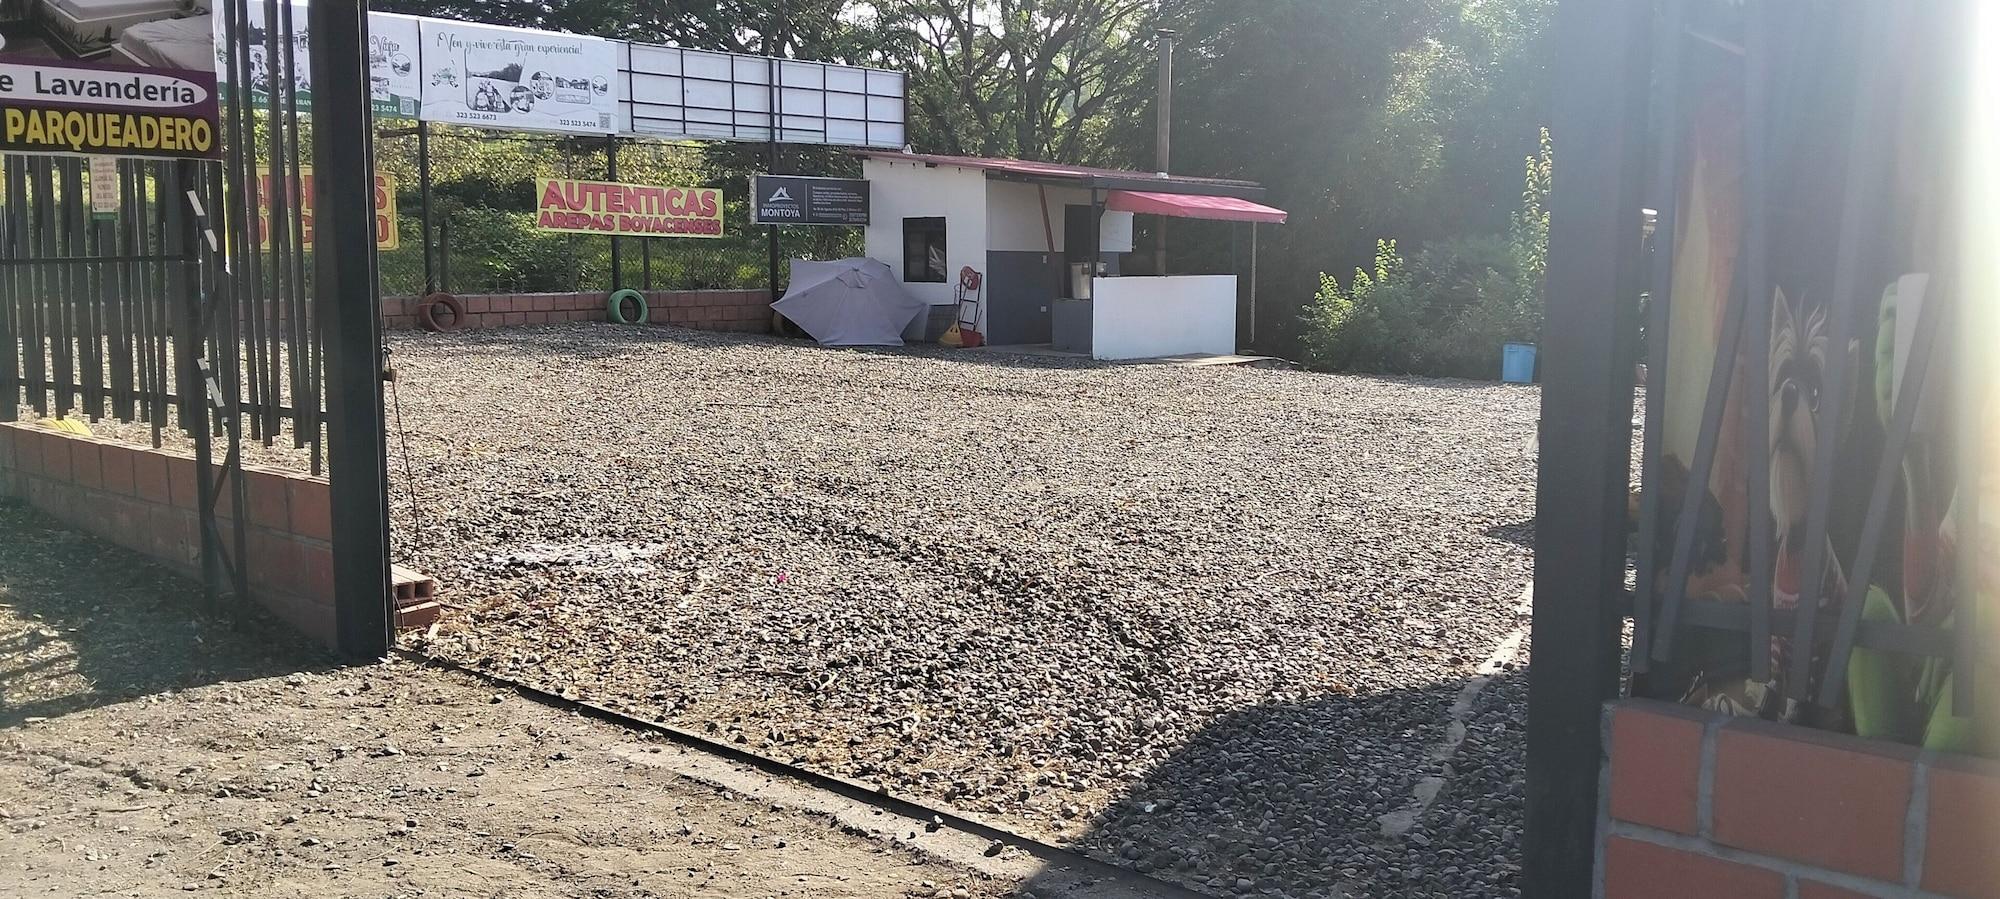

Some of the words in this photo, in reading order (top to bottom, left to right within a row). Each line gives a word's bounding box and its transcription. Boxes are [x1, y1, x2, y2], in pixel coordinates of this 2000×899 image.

[35, 71, 196, 103] Lavandería
[456, 111, 468, 119] 323
[469, 112, 481, 120] 523
[482, 113, 497, 121] 6673
[571, 119, 581, 127] 523
[582, 120, 597, 128] 5474
[5, 108, 211, 152] PARQUEADERO
[540, 181, 718, 218] AUTENTICAS
[538, 211, 615, 231] AREPAS
[619, 215, 722, 235] BOYACENSES
[761, 208, 801, 218] MONTOYA
